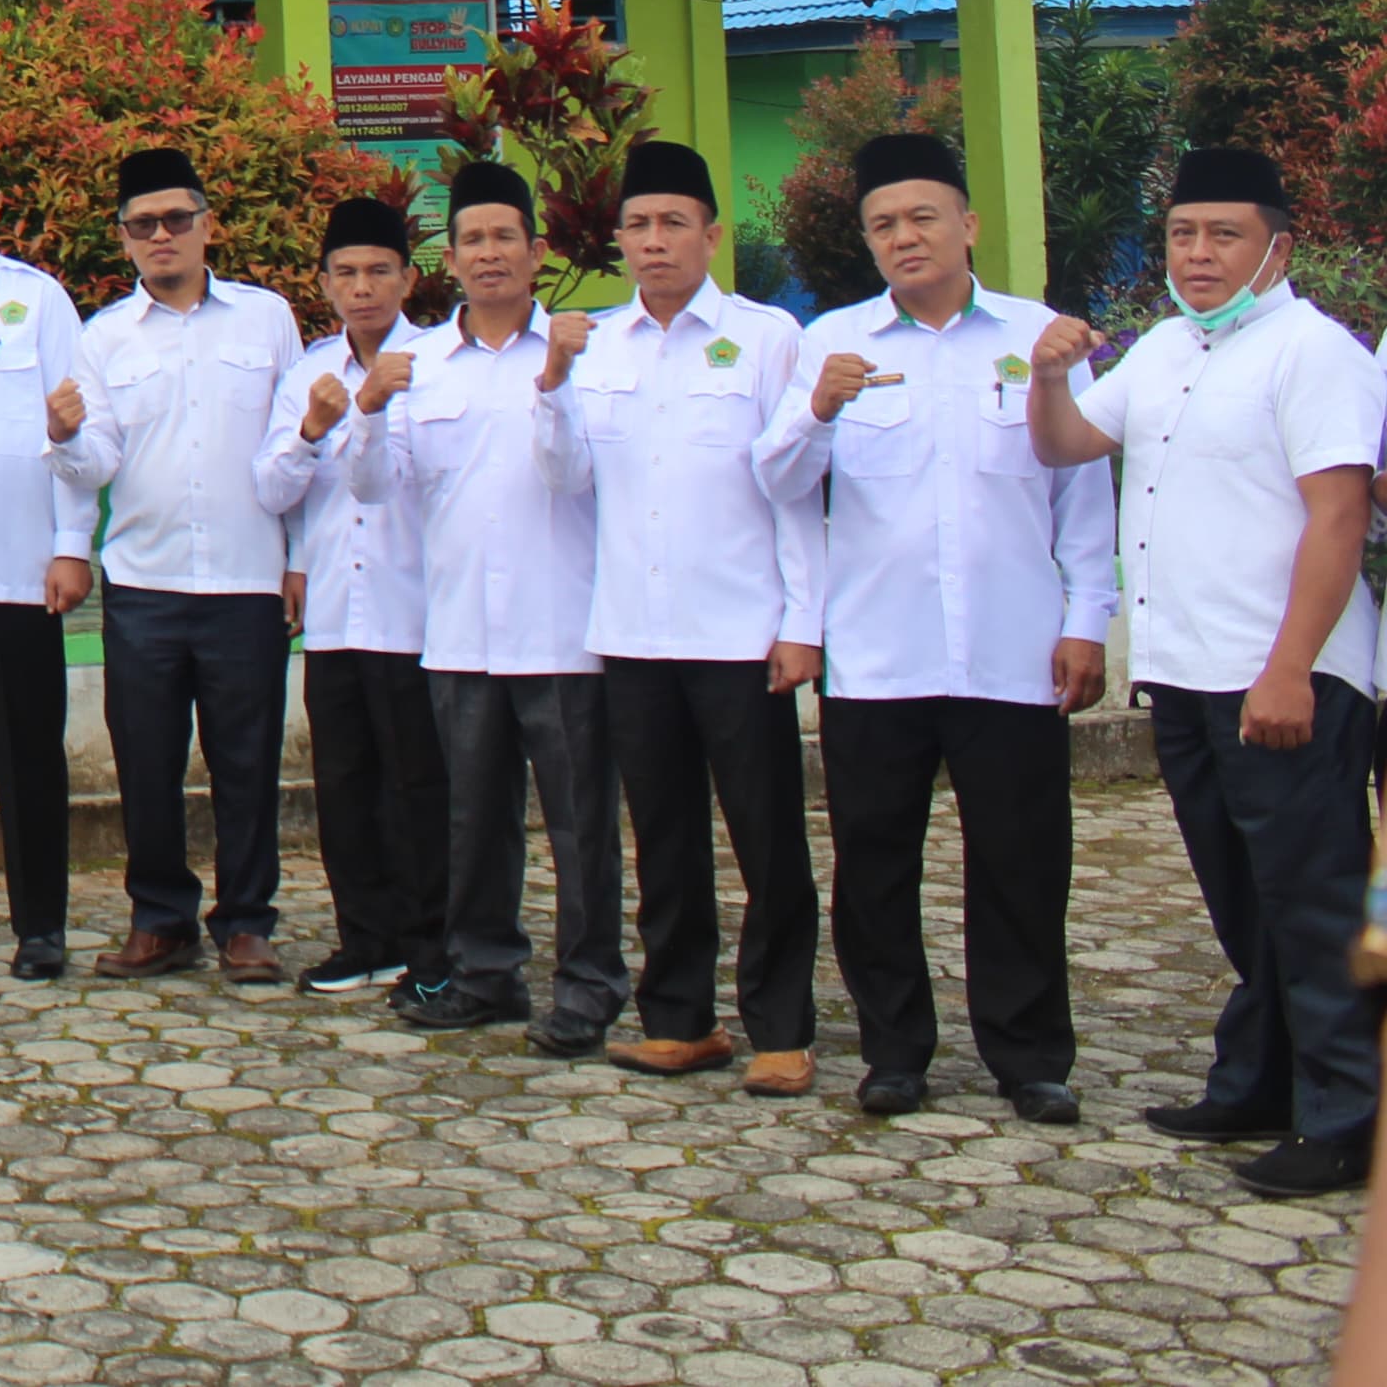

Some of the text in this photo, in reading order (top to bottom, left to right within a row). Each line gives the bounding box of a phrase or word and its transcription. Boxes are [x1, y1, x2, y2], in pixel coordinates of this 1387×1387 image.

[410, 20, 446, 35] STOP
[410, 37, 467, 51] BULLYING
[335, 71, 468, 85] LAYANAN PENGADN
